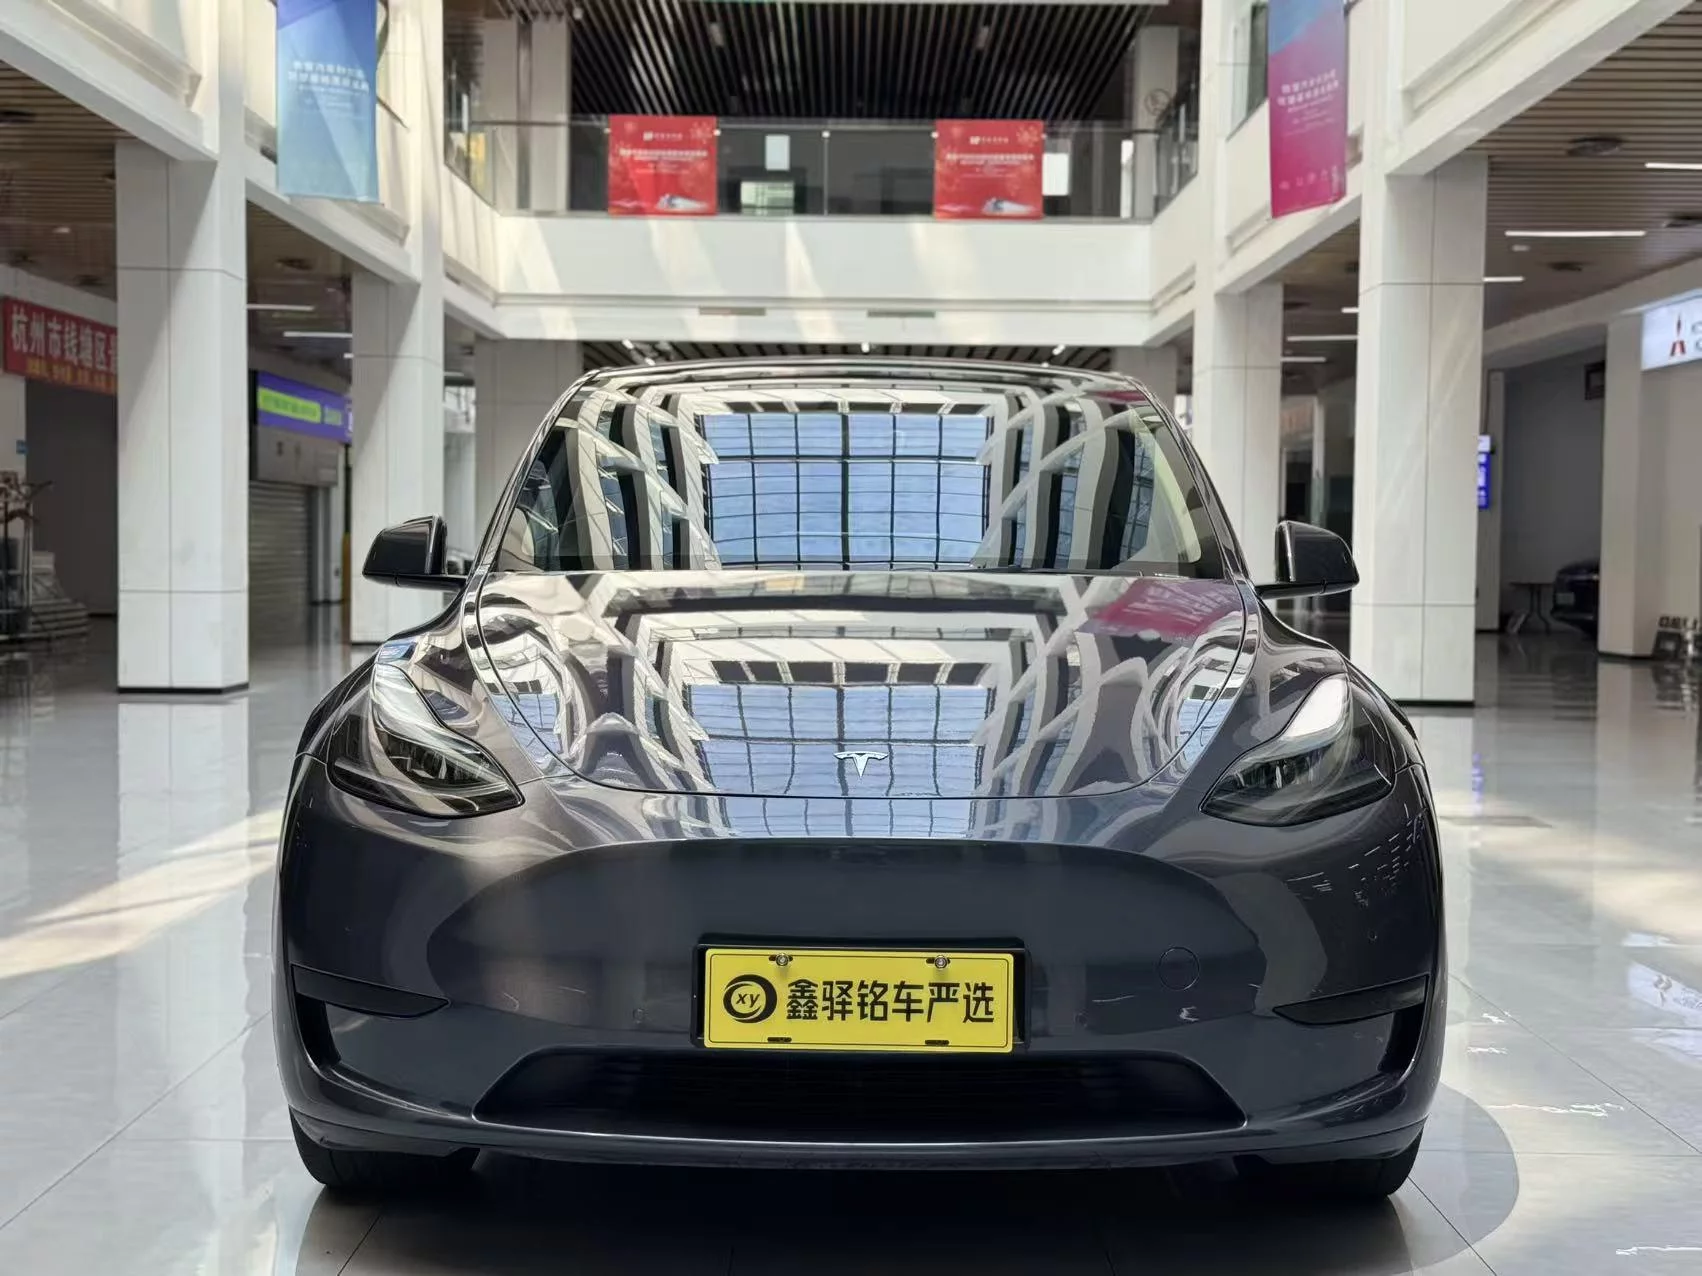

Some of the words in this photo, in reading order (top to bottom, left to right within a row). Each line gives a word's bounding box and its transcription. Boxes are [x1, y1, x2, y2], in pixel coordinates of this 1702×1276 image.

[786, 978, 995, 1023] 鑫驿铭车严选
